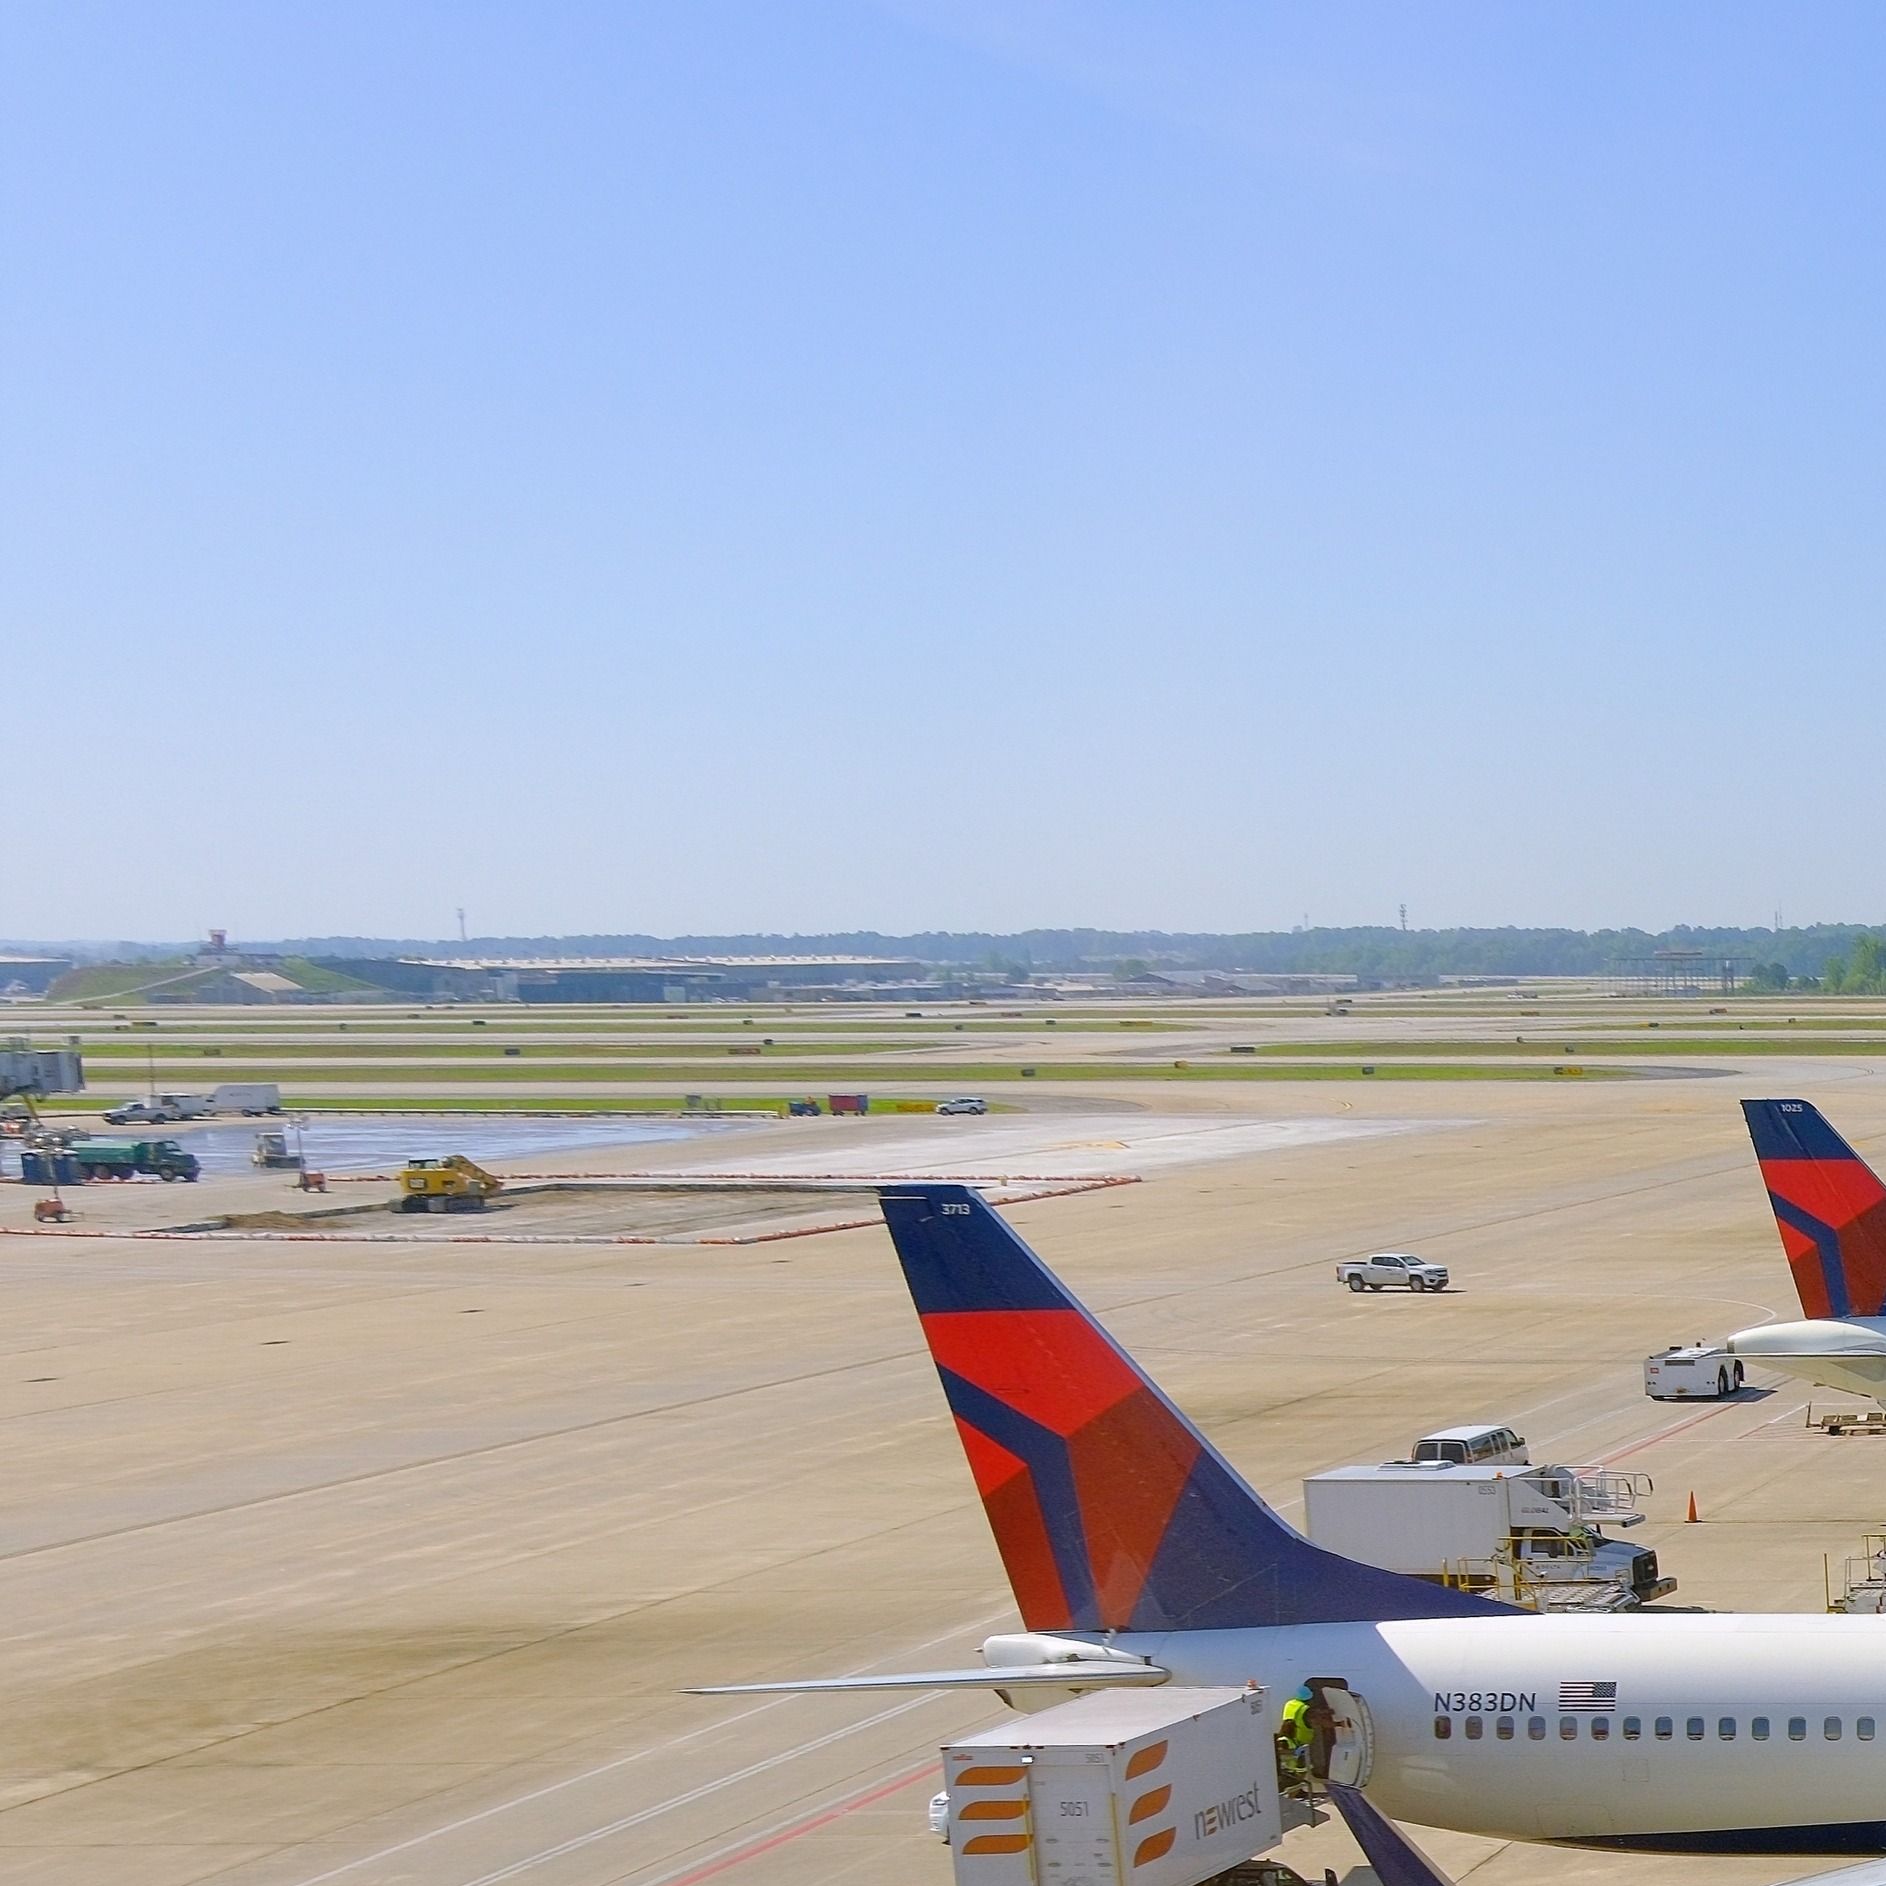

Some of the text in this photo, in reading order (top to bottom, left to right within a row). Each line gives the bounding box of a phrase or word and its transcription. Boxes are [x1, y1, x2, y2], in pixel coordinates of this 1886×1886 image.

[1781, 1104, 1803, 1113] 1025
[941, 1203, 970, 1216] 3713
[1434, 1692, 1537, 1712] N383DN
[1059, 1801, 1090, 1817] 5051
